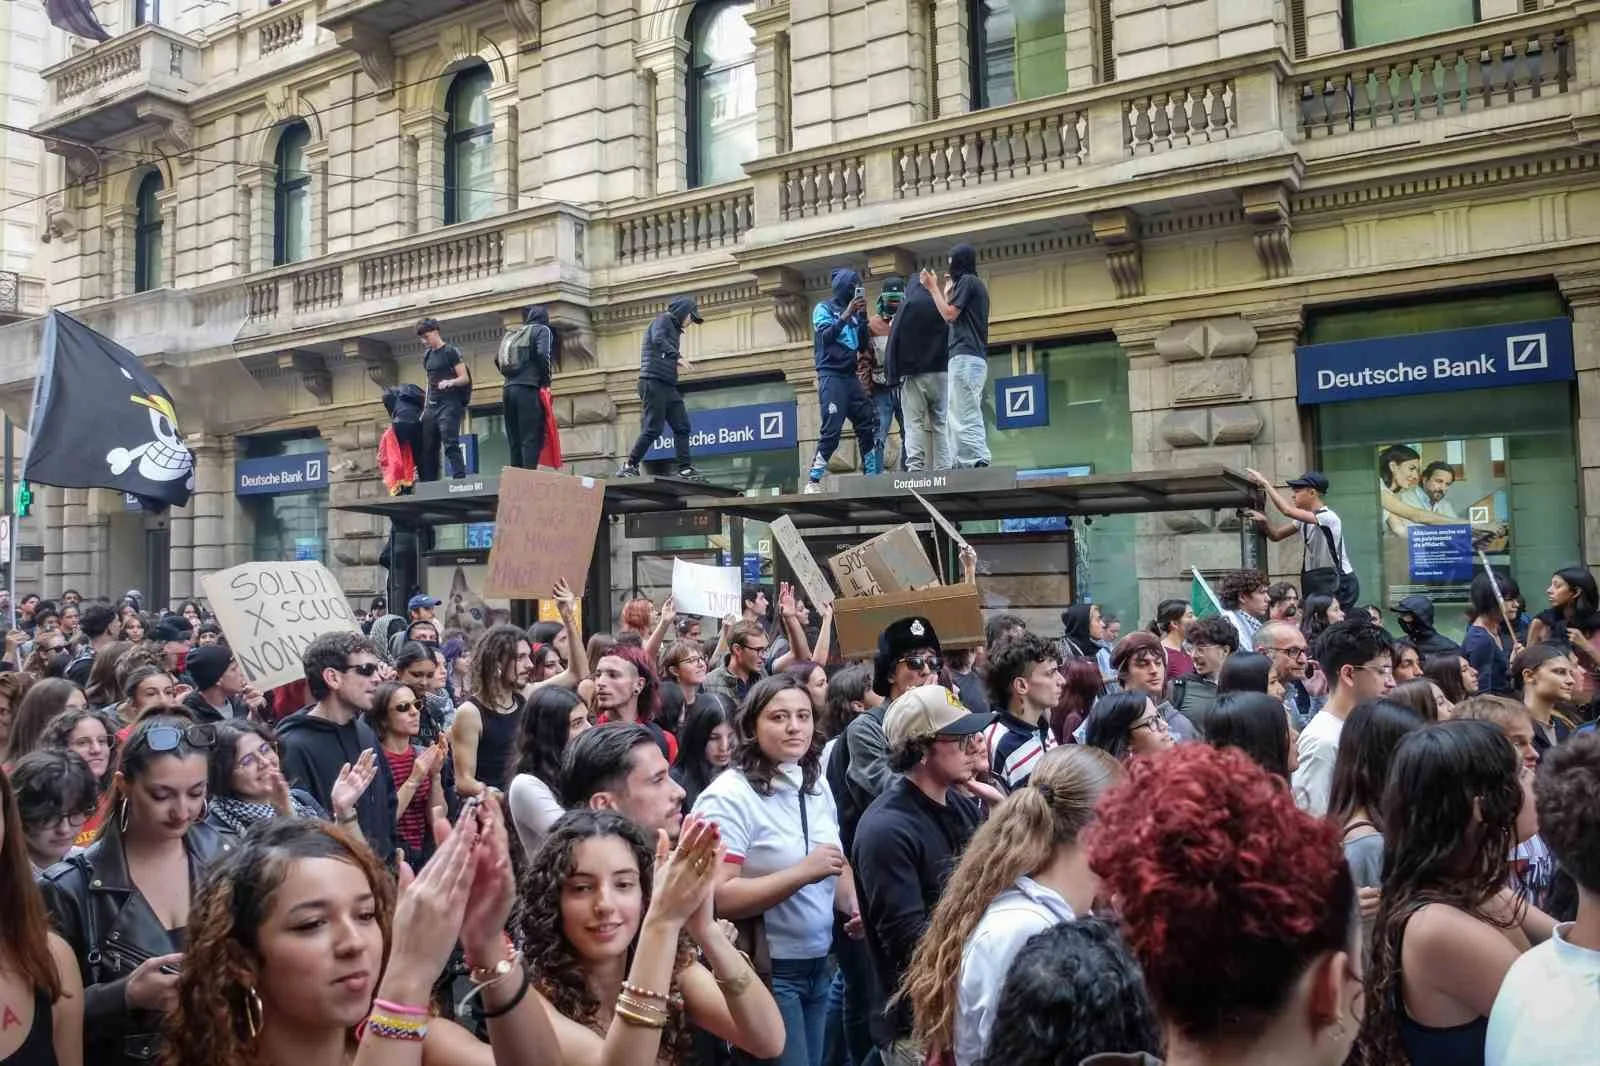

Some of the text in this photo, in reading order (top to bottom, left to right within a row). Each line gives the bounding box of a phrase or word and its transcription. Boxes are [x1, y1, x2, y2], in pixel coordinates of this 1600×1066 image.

[1317, 354, 1497, 390] Deutsche Bank
[719, 426, 754, 443] Bank
[241, 470, 304, 487] Deutsche Bank
[894, 476, 946, 488] Cordusio M1
[231, 569, 327, 601] SOLDI
[244, 602, 275, 637] X
